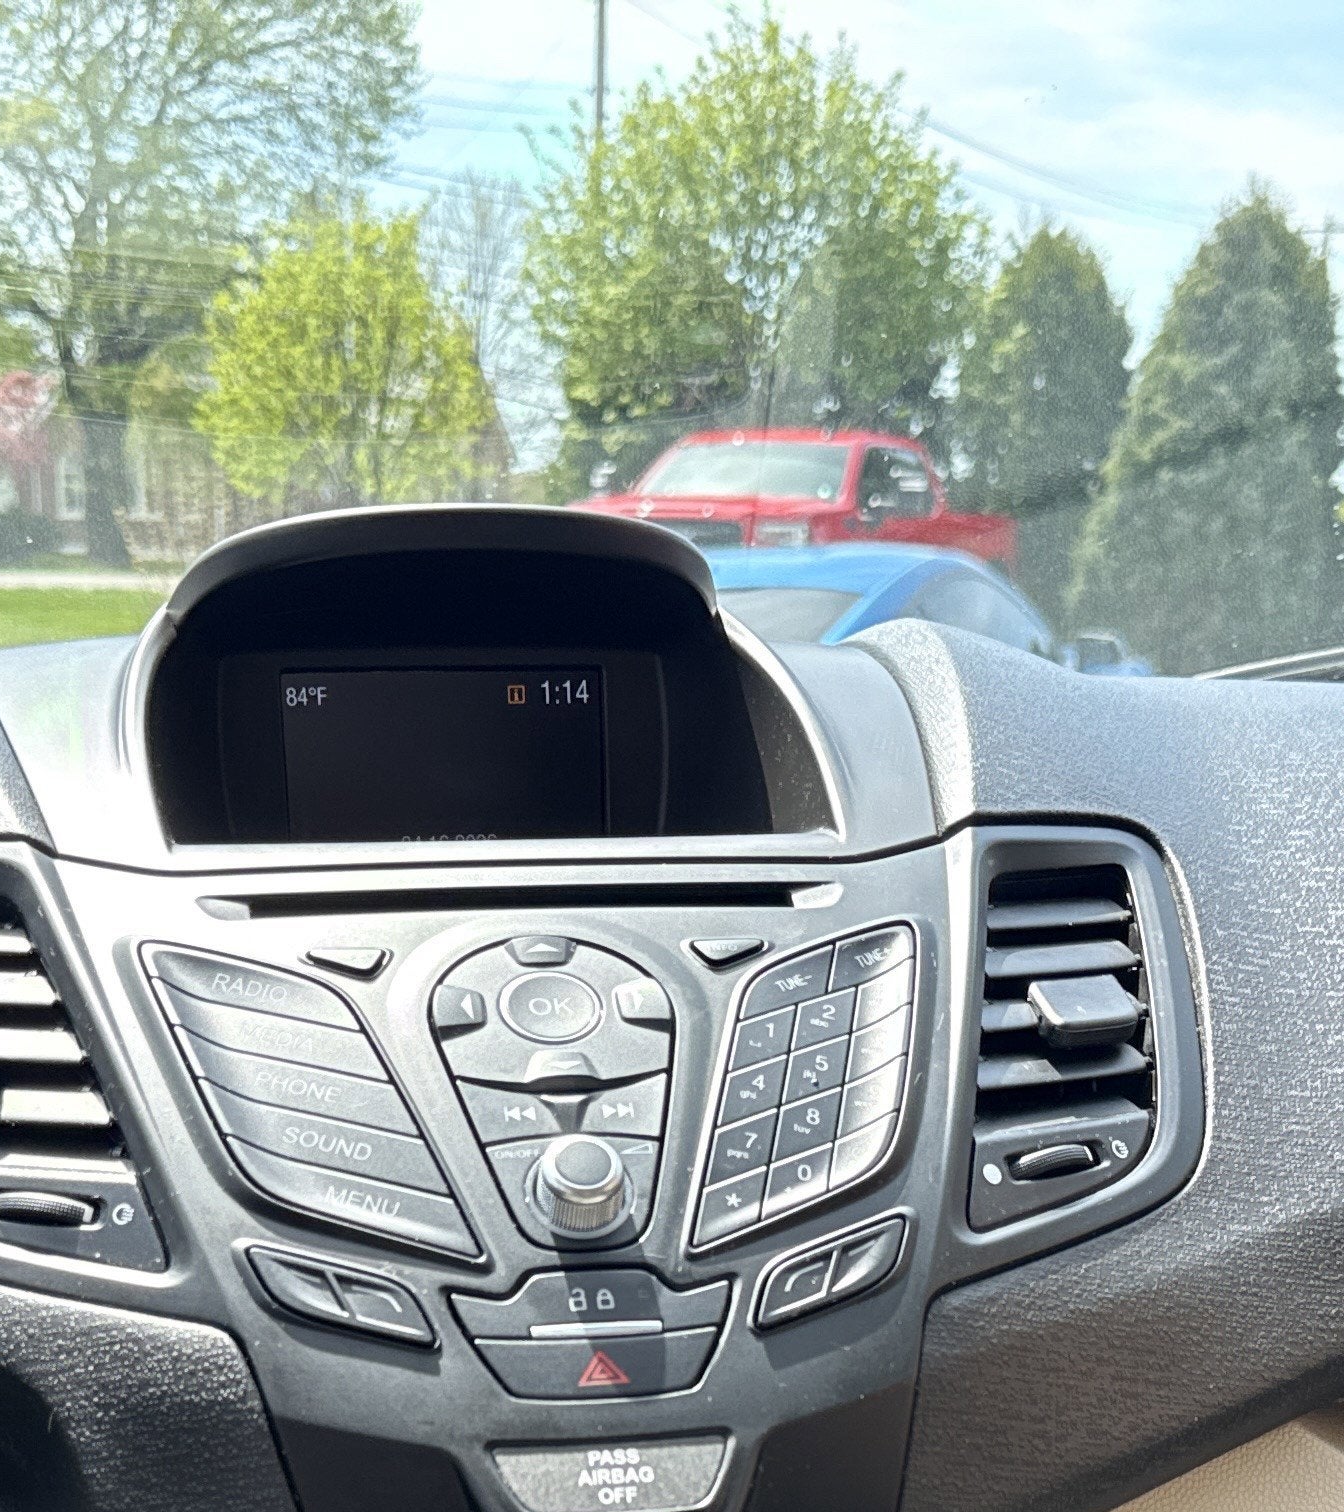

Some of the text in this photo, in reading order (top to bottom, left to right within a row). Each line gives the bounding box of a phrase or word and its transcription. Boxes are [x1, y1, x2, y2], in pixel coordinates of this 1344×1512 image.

[285, 686, 328, 707] 84°F
[541, 679, 590, 705] 1:14
[211, 973, 288, 1003] RADIO
[528, 997, 572, 1016] OK
[822, 1004, 836, 1020] 2
[765, 1022, 775, 1038] 1
[814, 1054, 829, 1072] 5
[255, 1071, 343, 1104] PHONE
[752, 1075, 766, 1090] 4
[806, 1108, 820, 1125] 8
[282, 1126, 373, 1161] SOUND
[744, 1132, 758, 1148] 7
[797, 1164, 812, 1181] 0
[325, 1184, 401, 1218] MENU
[587, 1448, 640, 1467] PASS
[578, 1465, 655, 1487] AIRBAG
[598, 1486, 637, 1505] OFF
